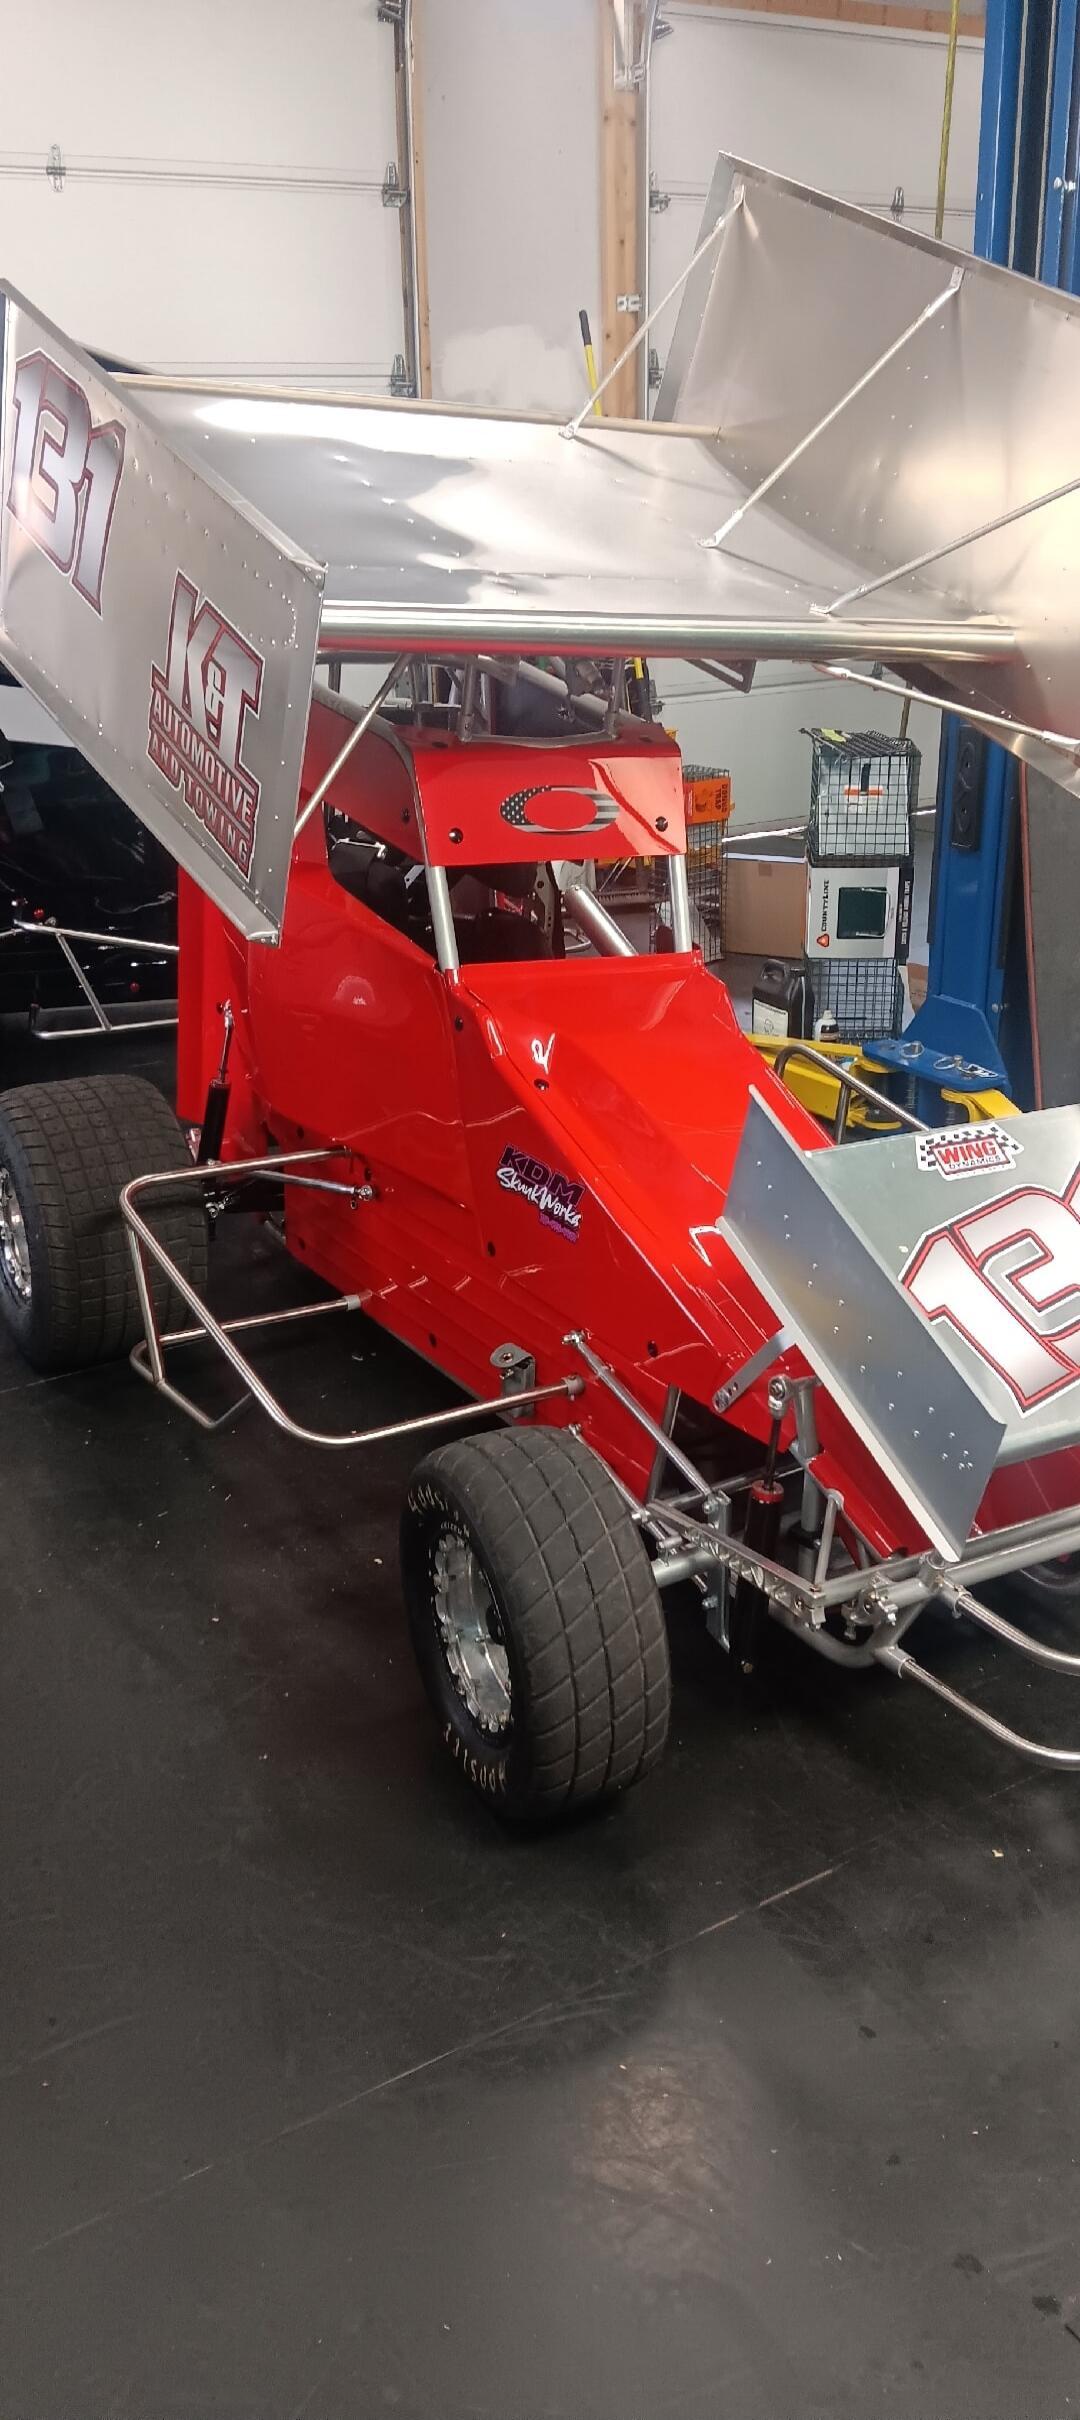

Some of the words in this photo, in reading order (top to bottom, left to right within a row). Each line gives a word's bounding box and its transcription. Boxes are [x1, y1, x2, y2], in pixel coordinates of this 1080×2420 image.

[7, 344, 126, 615] 131
[152, 572, 263, 778] K&T
[151, 735, 180, 782] AND
[186, 774, 249, 865] TOWING
[152, 697, 252, 823] AUTOMOTIVE
[500, 1144, 585, 1208] KDM
[938, 1140, 997, 1164] WING
[949, 1155, 1001, 1169] DYNAMICS
[899, 1160, 1080, 1417] 13
